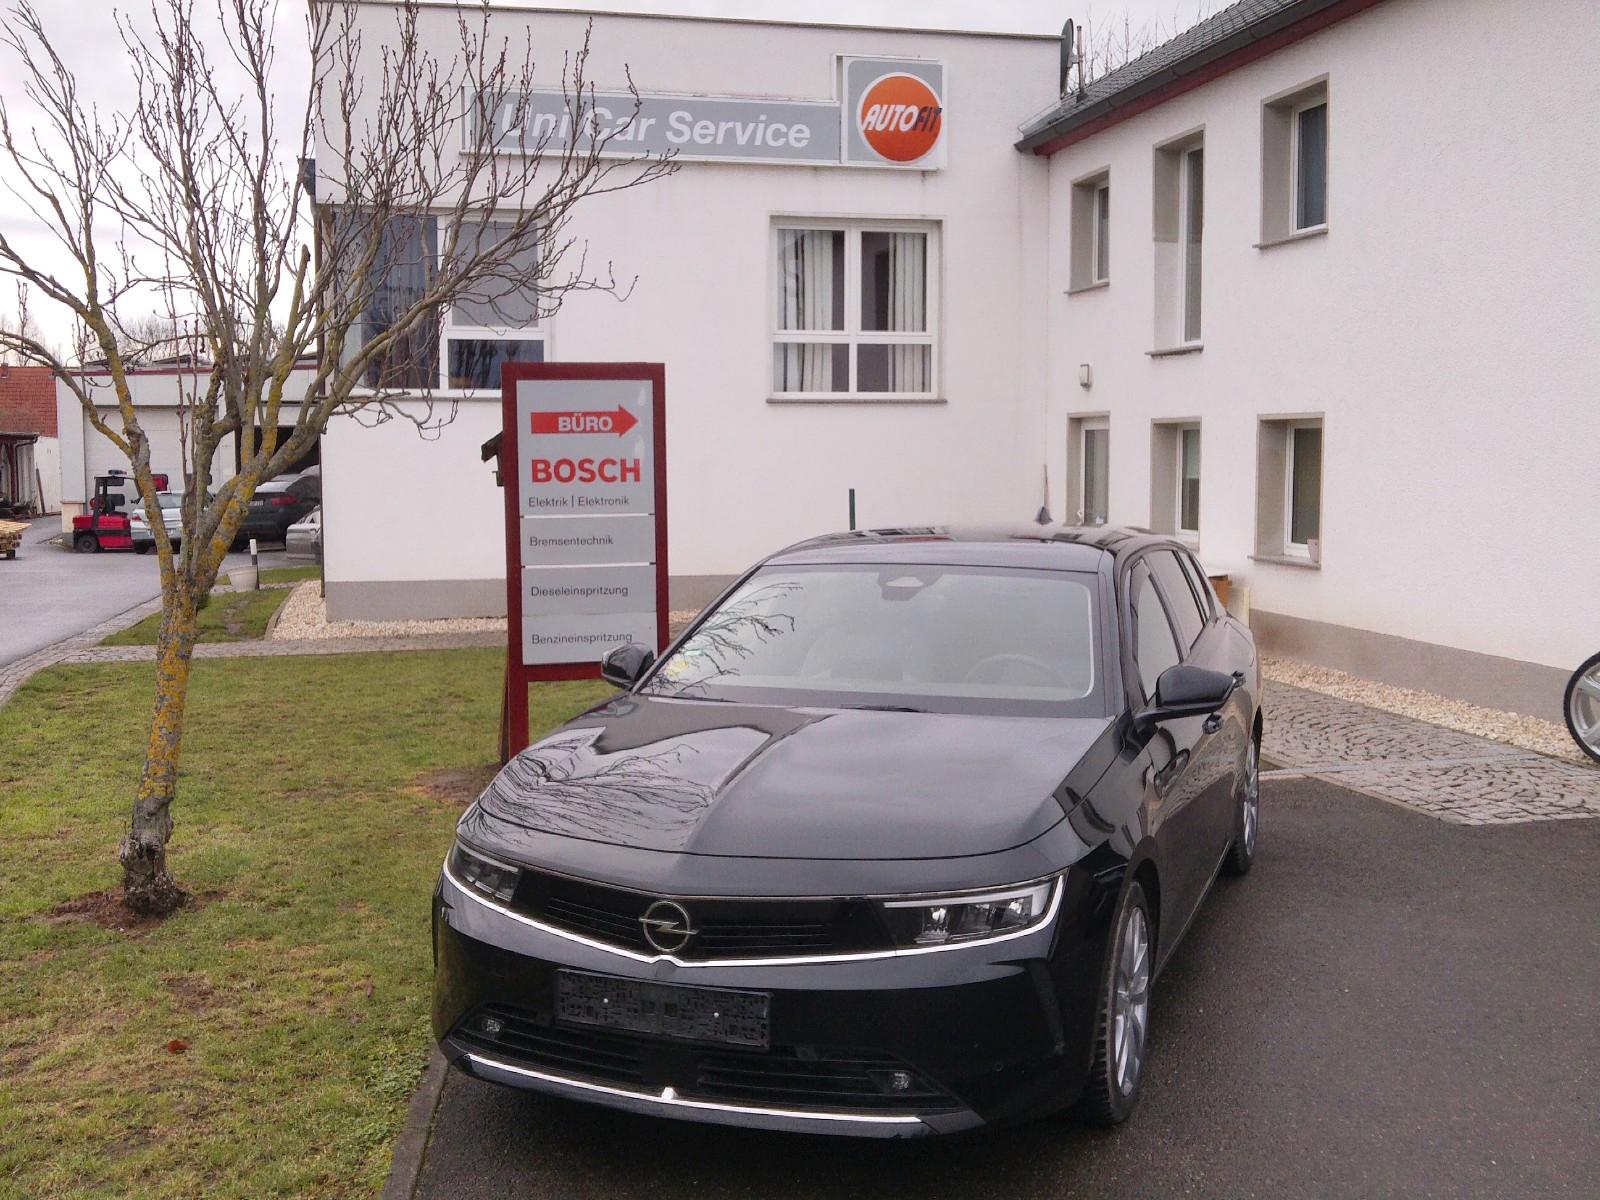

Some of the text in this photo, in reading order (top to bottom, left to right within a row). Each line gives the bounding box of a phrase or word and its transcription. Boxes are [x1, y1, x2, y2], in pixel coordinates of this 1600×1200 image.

[862, 103, 943, 132] AUTOFIT
[502, 103, 811, 148] Uni Car Service
[558, 413, 613, 431] BÜRO
[531, 458, 641, 483] BOSCH
[528, 496, 569, 508] Elektrik
[578, 495, 630, 507] Elektronik
[529, 535, 614, 547] Bremsentechnik
[530, 585, 629, 598] Dieseleinspritzung
[531, 632, 633, 645] Benzineinspritzung
